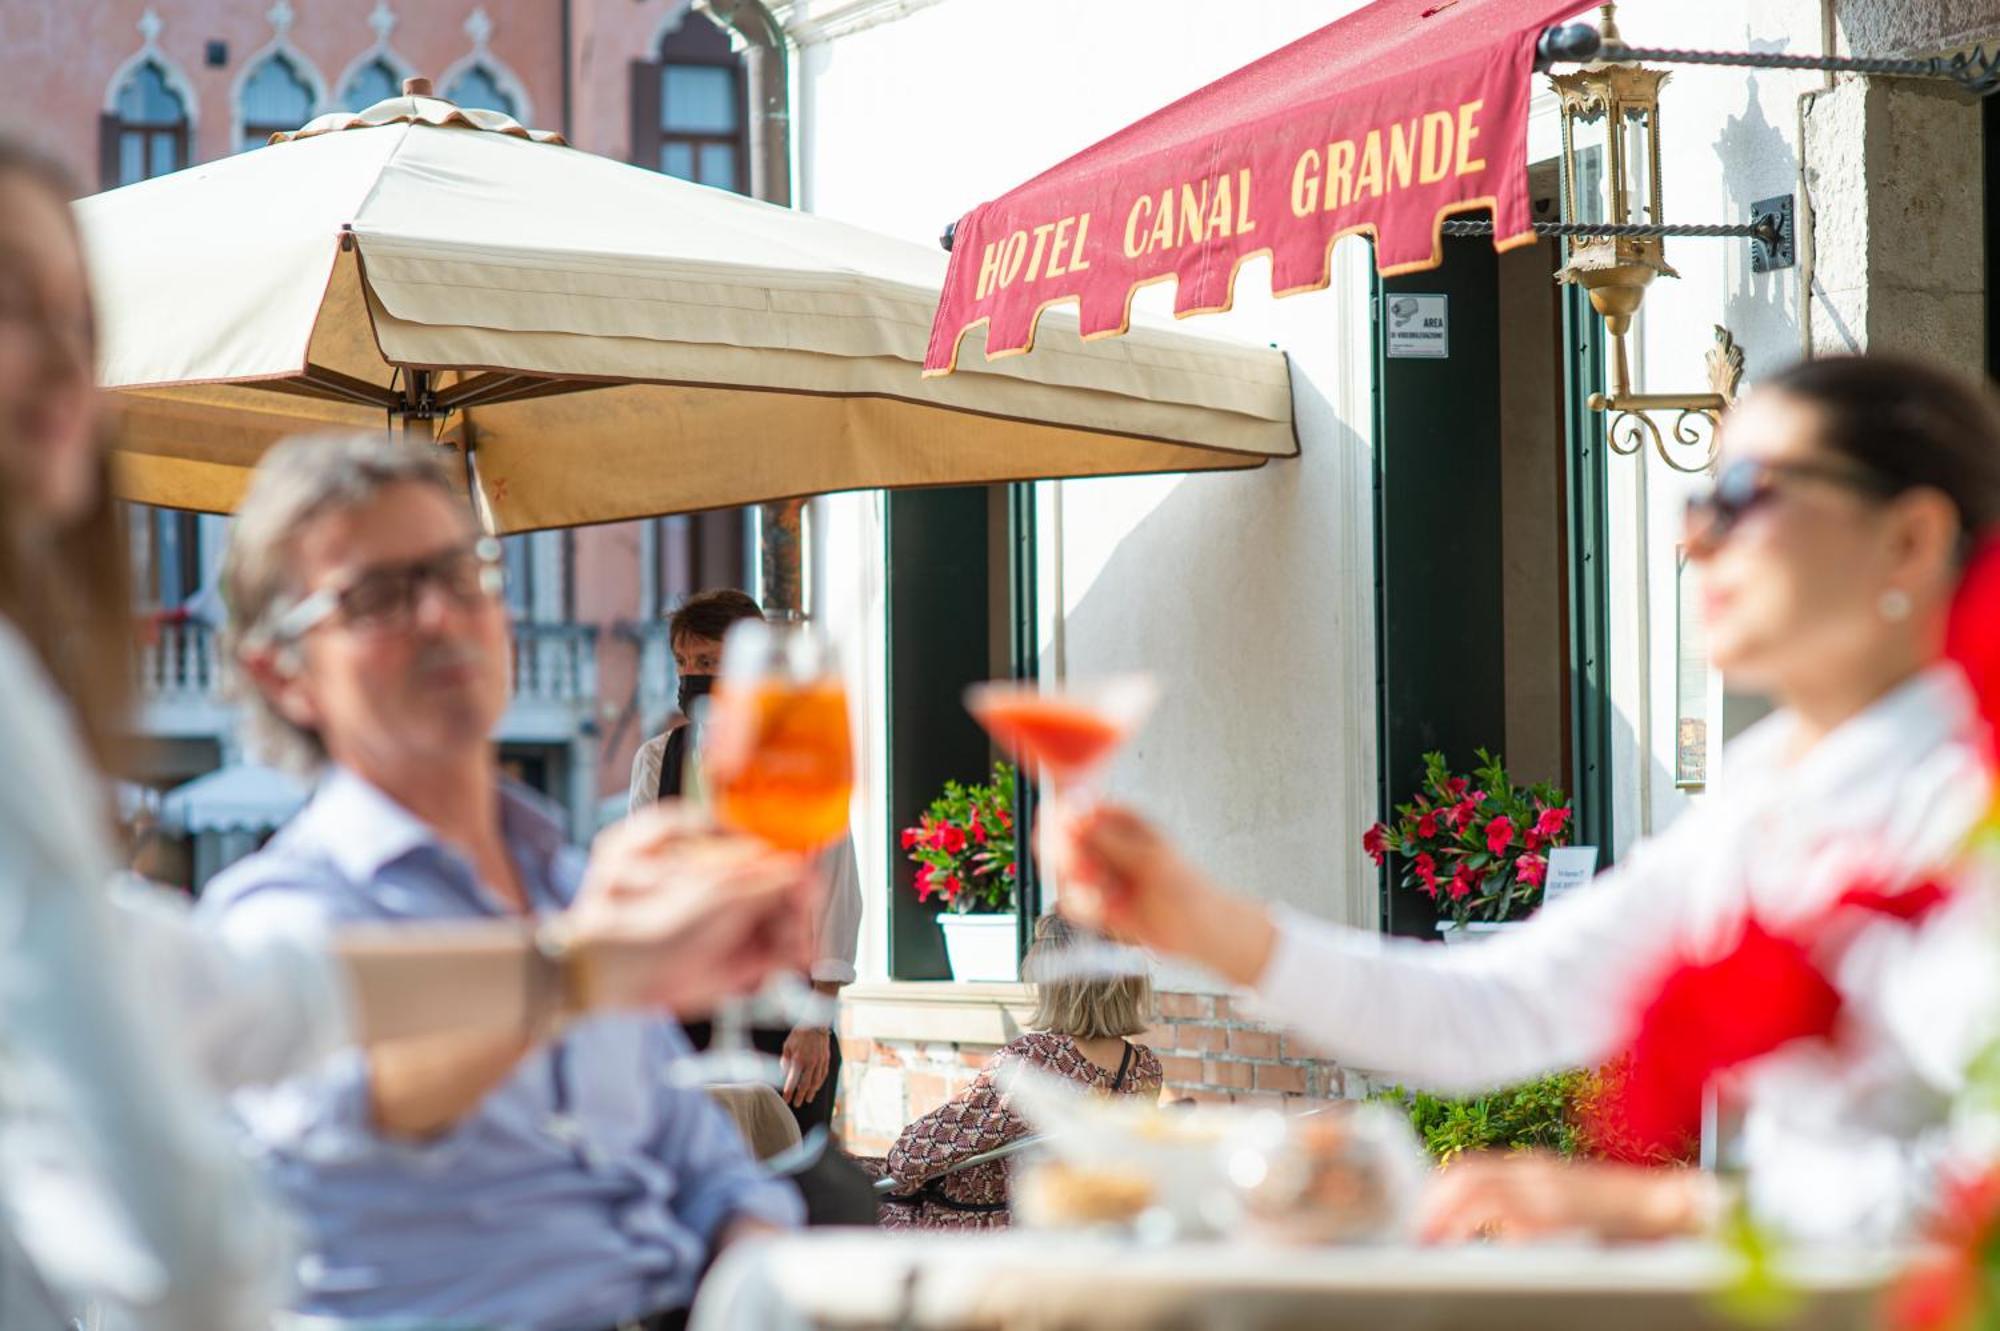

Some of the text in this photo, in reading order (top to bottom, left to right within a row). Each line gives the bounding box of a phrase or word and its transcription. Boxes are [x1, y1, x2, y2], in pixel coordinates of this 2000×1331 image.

[976, 101, 1487, 300] HOTEL CANAL GRANDE
[1423, 318, 1443, 328] AREA
